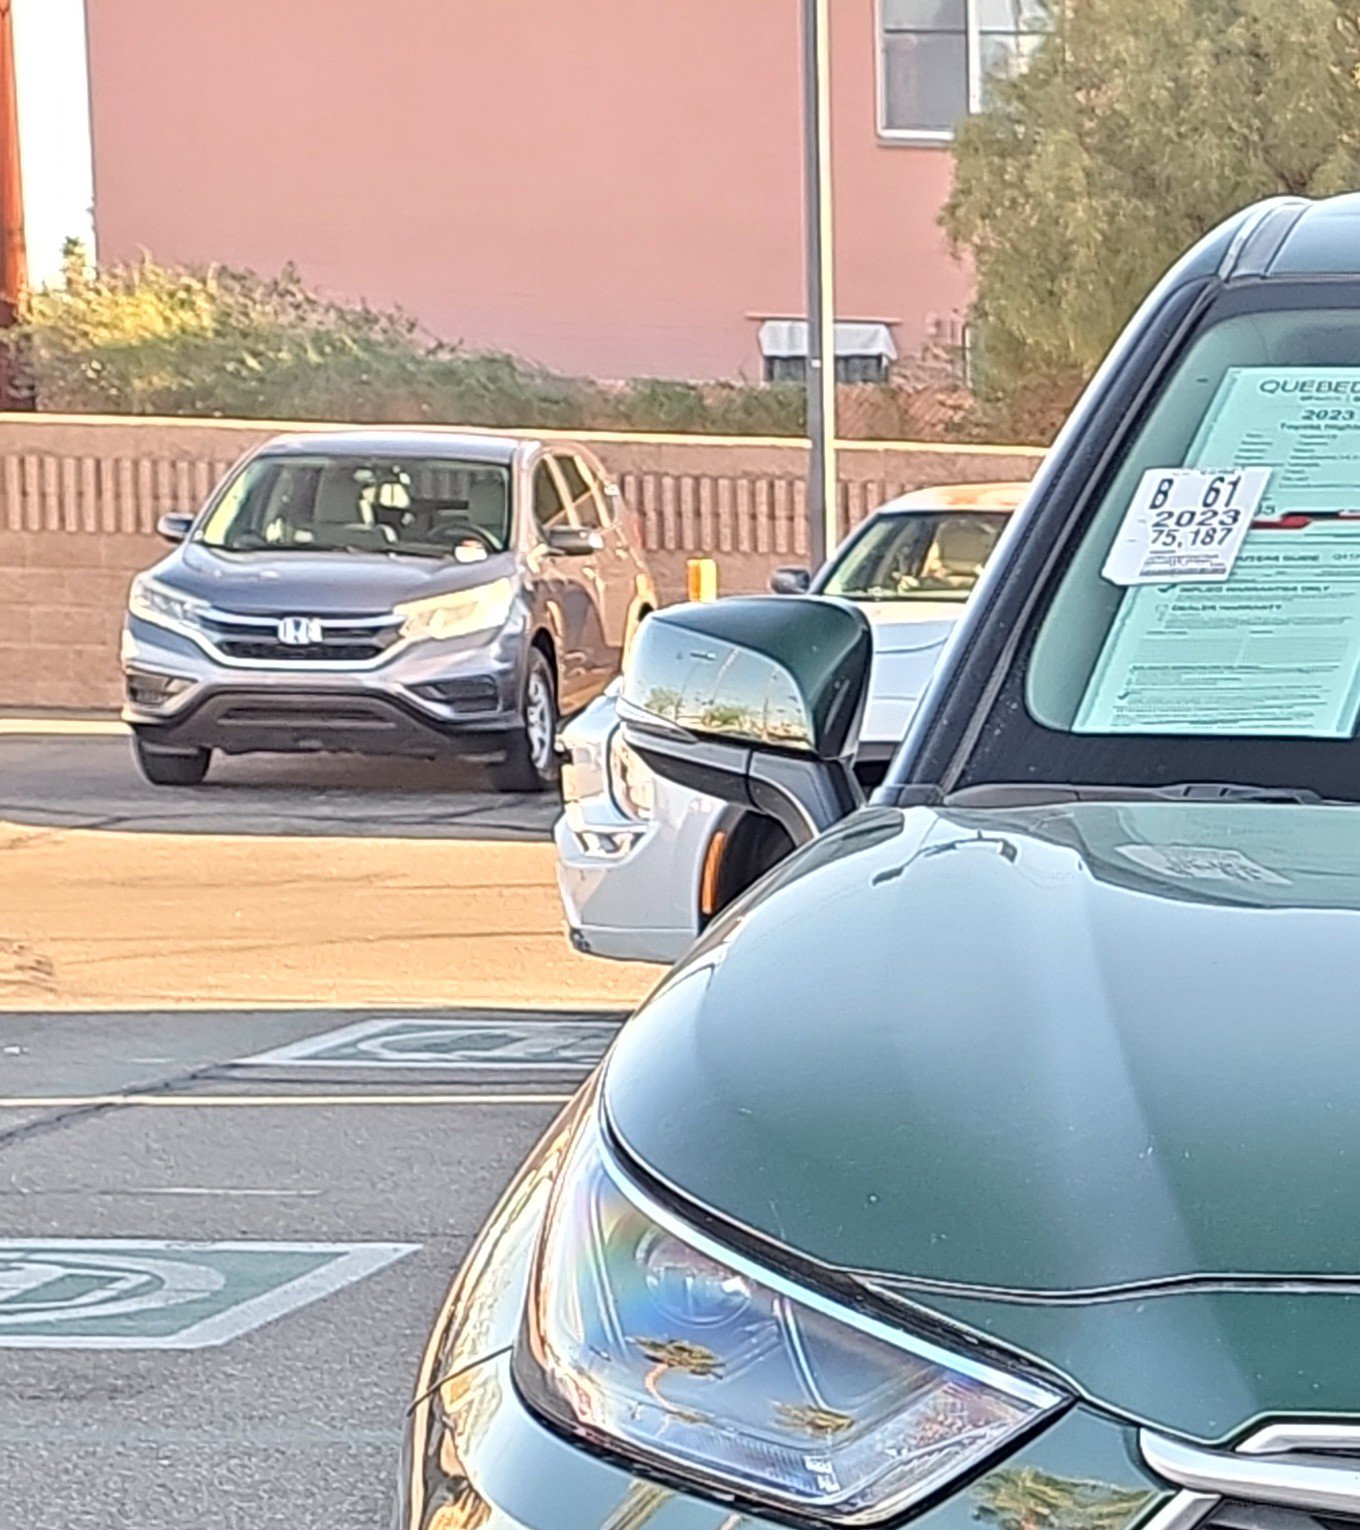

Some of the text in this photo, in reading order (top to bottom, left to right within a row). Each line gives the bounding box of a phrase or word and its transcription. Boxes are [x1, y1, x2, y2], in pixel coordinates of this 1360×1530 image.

[1301, 409, 1355, 421] 2023
[1202, 475, 1242, 508] 61
[1151, 509, 1241, 528] 2023
[1151, 527, 1234, 548] 75,187
